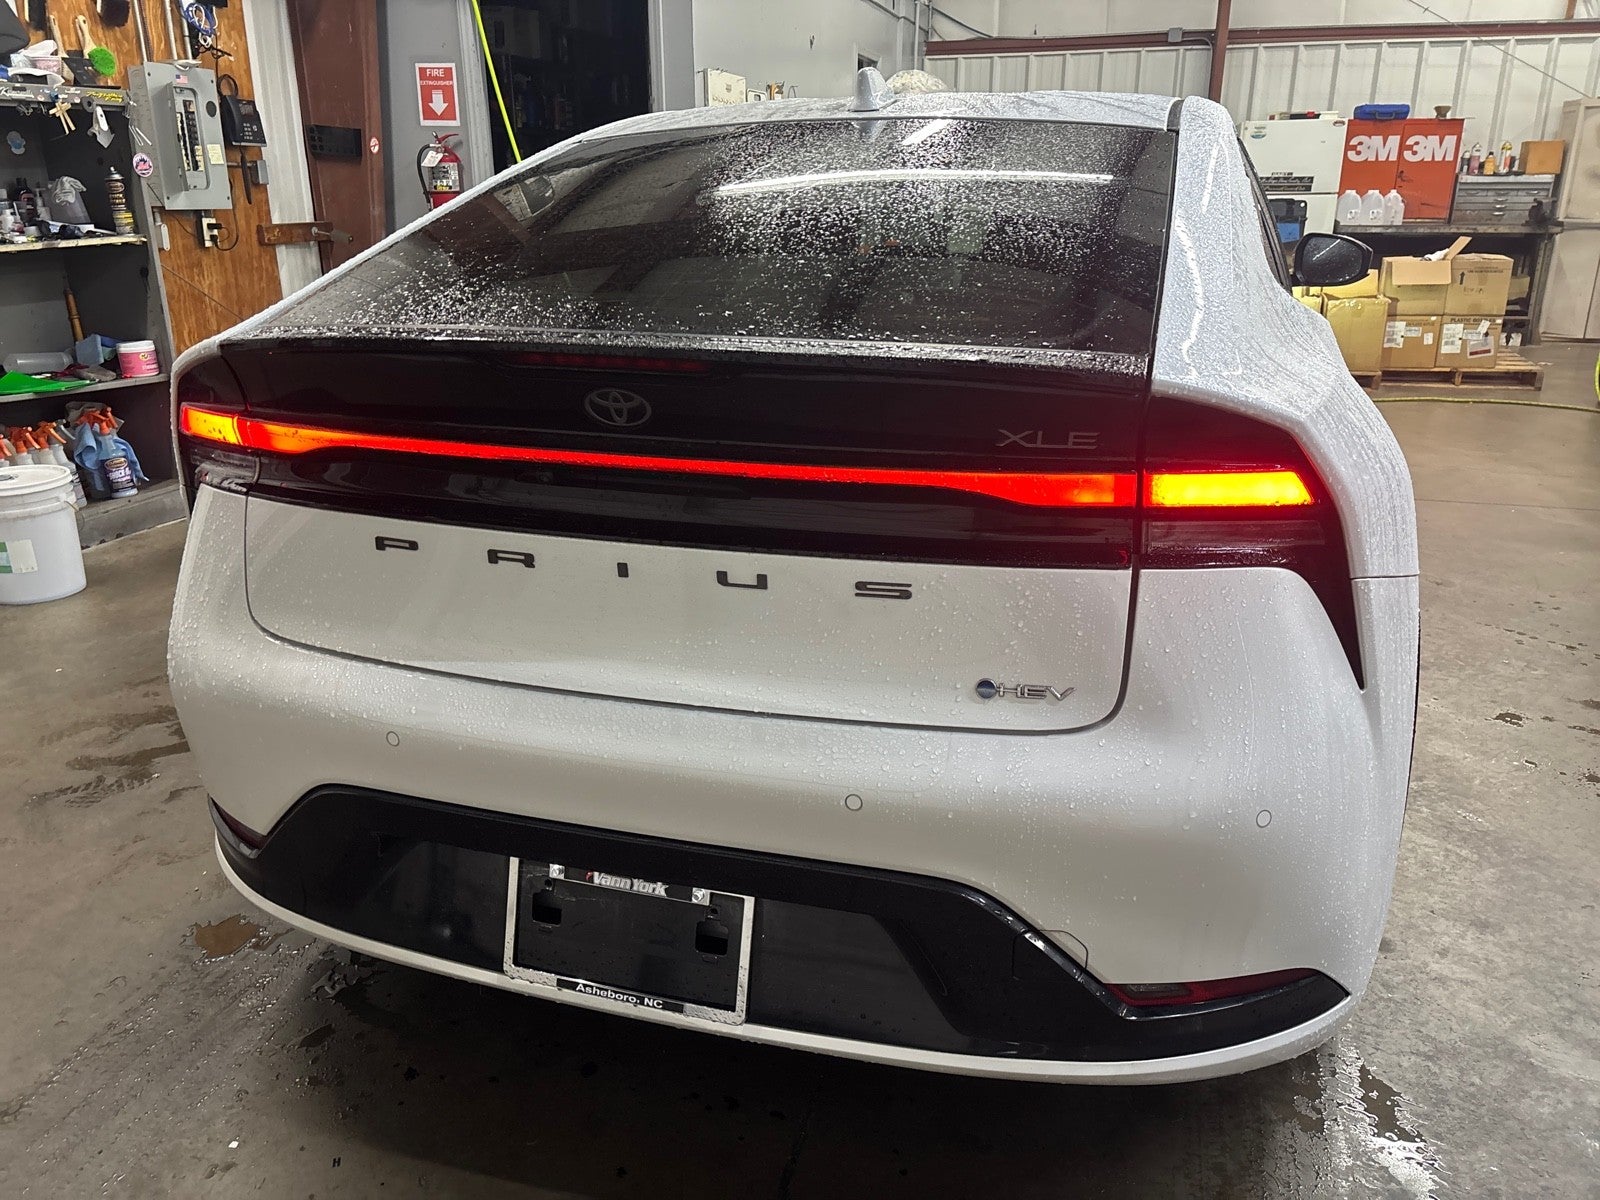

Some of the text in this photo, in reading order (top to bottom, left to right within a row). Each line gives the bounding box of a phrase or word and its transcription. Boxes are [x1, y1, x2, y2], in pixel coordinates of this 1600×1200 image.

[426, 68, 445, 77] FIRE
[1347, 134, 1401, 162] 3M
[1403, 134, 1457, 162] 3M
[995, 429, 1100, 450] XLE
[375, 536, 912, 600] PRIUS
[998, 682, 1077, 701] HEV
[575, 983, 663, 1009] Asheboro, NC
